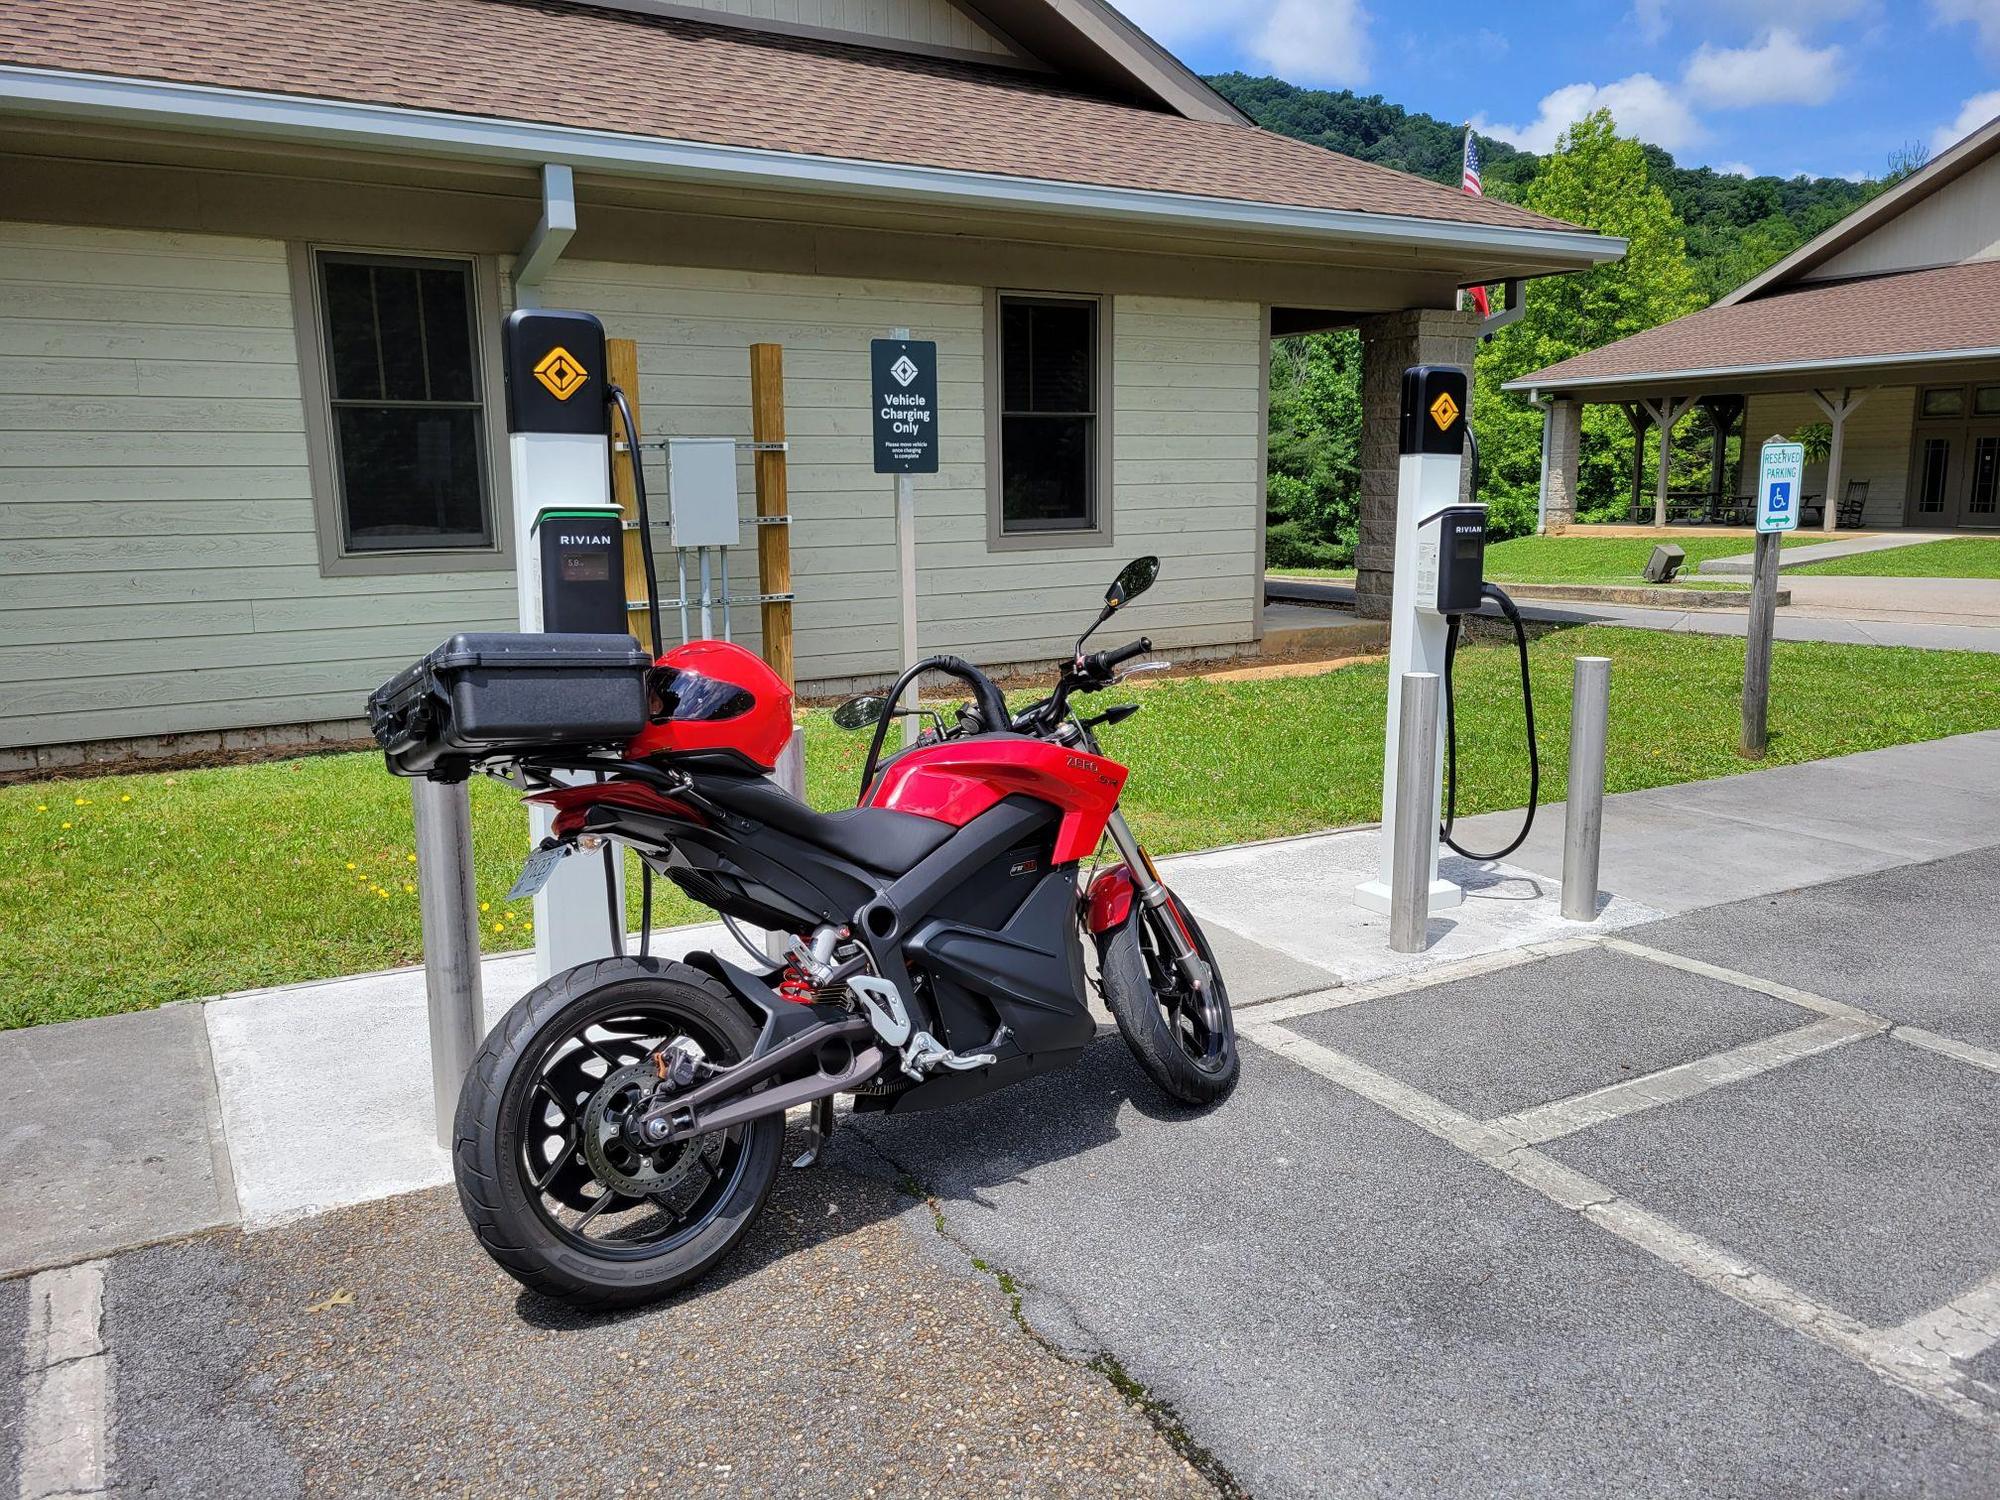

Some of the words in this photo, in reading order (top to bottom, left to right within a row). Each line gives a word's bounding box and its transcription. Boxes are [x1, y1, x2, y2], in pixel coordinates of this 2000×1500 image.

[884, 394, 926, 406] Vehicle
[881, 408, 930, 422] Charging
[893, 421, 919, 436] Only
[1764, 452, 1801, 464] RESERVED
[1766, 467, 1797, 479] PARKING
[560, 535, 611, 545] RIVIAN
[1066, 755, 1098, 773] ZERO
